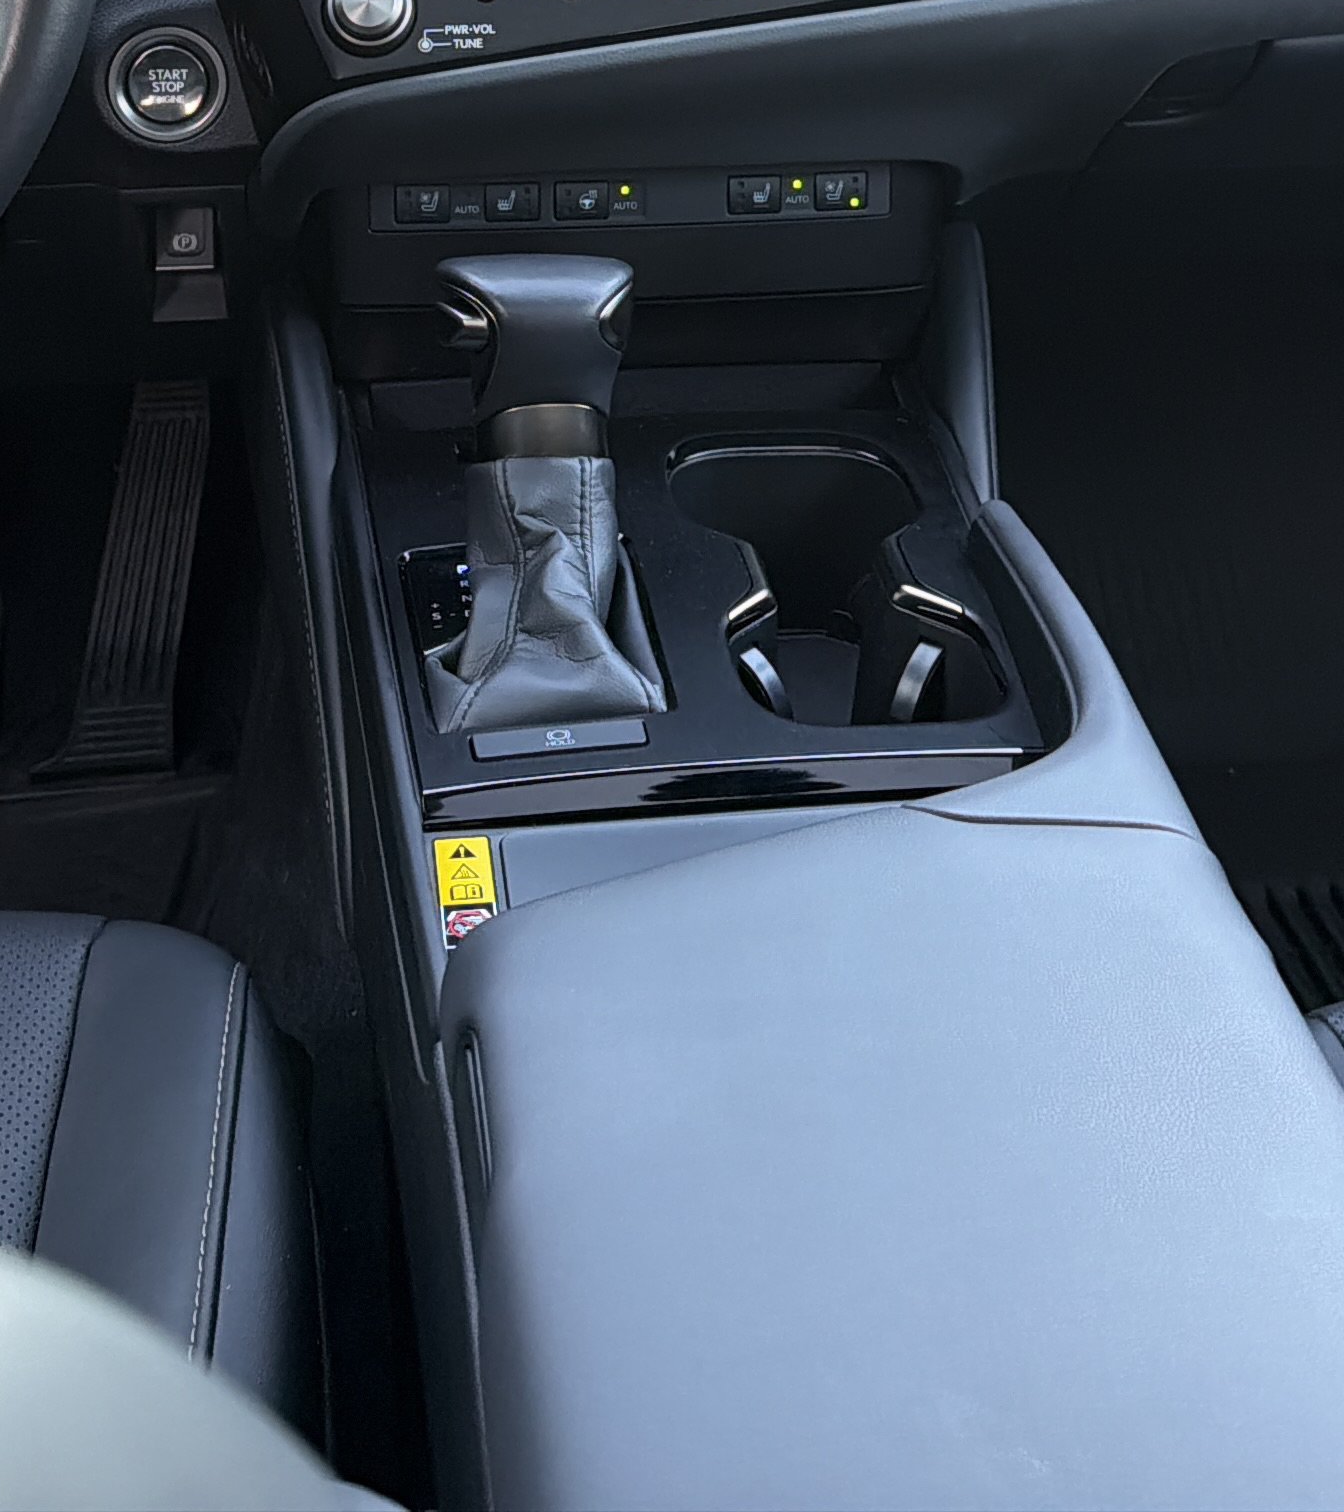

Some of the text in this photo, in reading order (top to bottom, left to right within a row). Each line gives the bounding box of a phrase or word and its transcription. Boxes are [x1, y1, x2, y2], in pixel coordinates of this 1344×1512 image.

[453, 39, 484, 49] TUNE
[148, 69, 189, 81] START
[152, 81, 185, 93] STOP
[785, 195, 810, 204] AUTO
[454, 204, 480, 215] AUTO
[613, 201, 638, 211] AUTO
[462, 595, 473, 603] N
[432, 612, 442, 621] S
